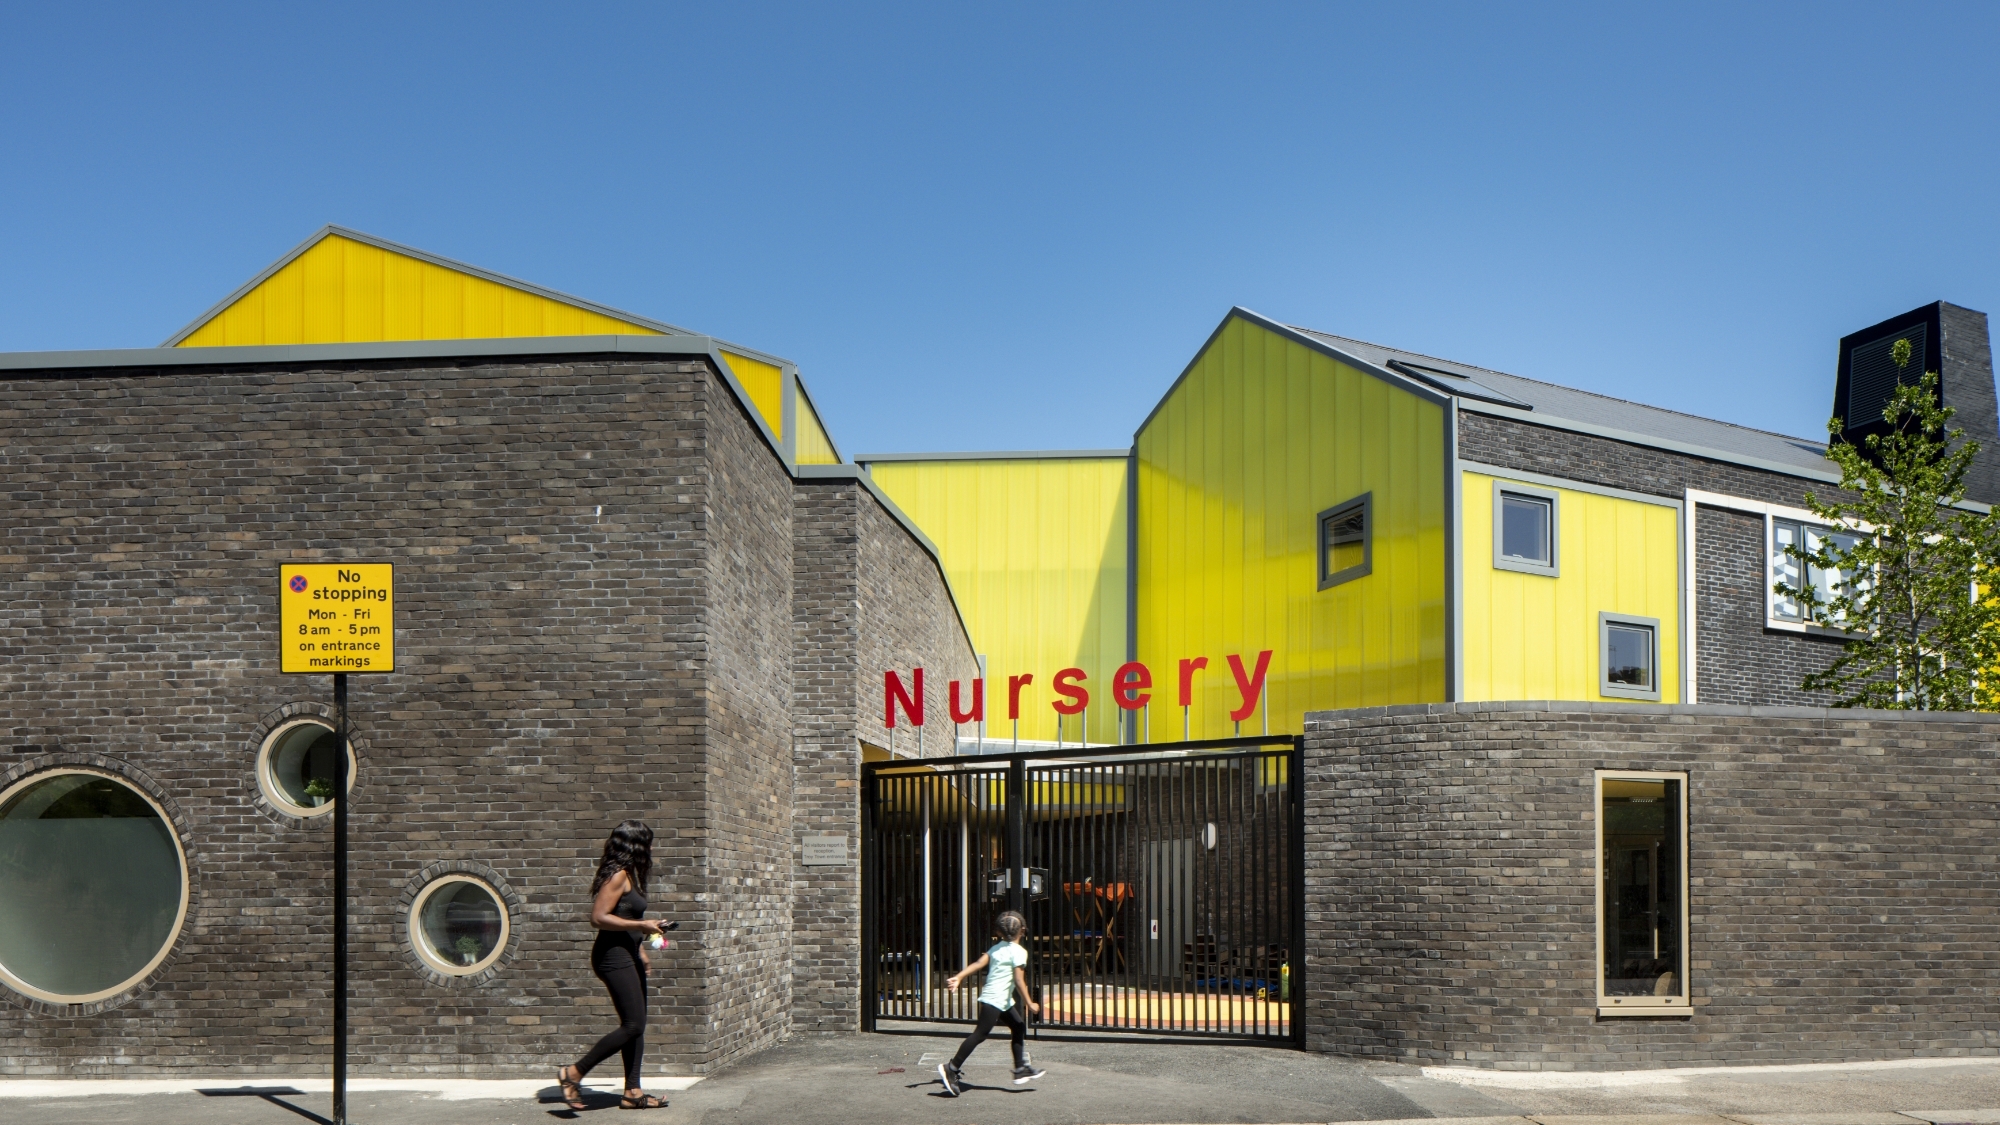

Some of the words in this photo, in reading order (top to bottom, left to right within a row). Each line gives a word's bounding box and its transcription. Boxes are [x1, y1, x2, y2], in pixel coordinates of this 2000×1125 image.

[338, 570, 360, 582] No
[312, 586, 387, 602] stopping
[308, 609, 336, 620] Mon
[354, 608, 370, 619] Fri
[299, 643, 315, 651] on
[322, 640, 380, 651] entrance
[310, 656, 370, 668] markings
[884, 649, 1273, 729] Nursery
